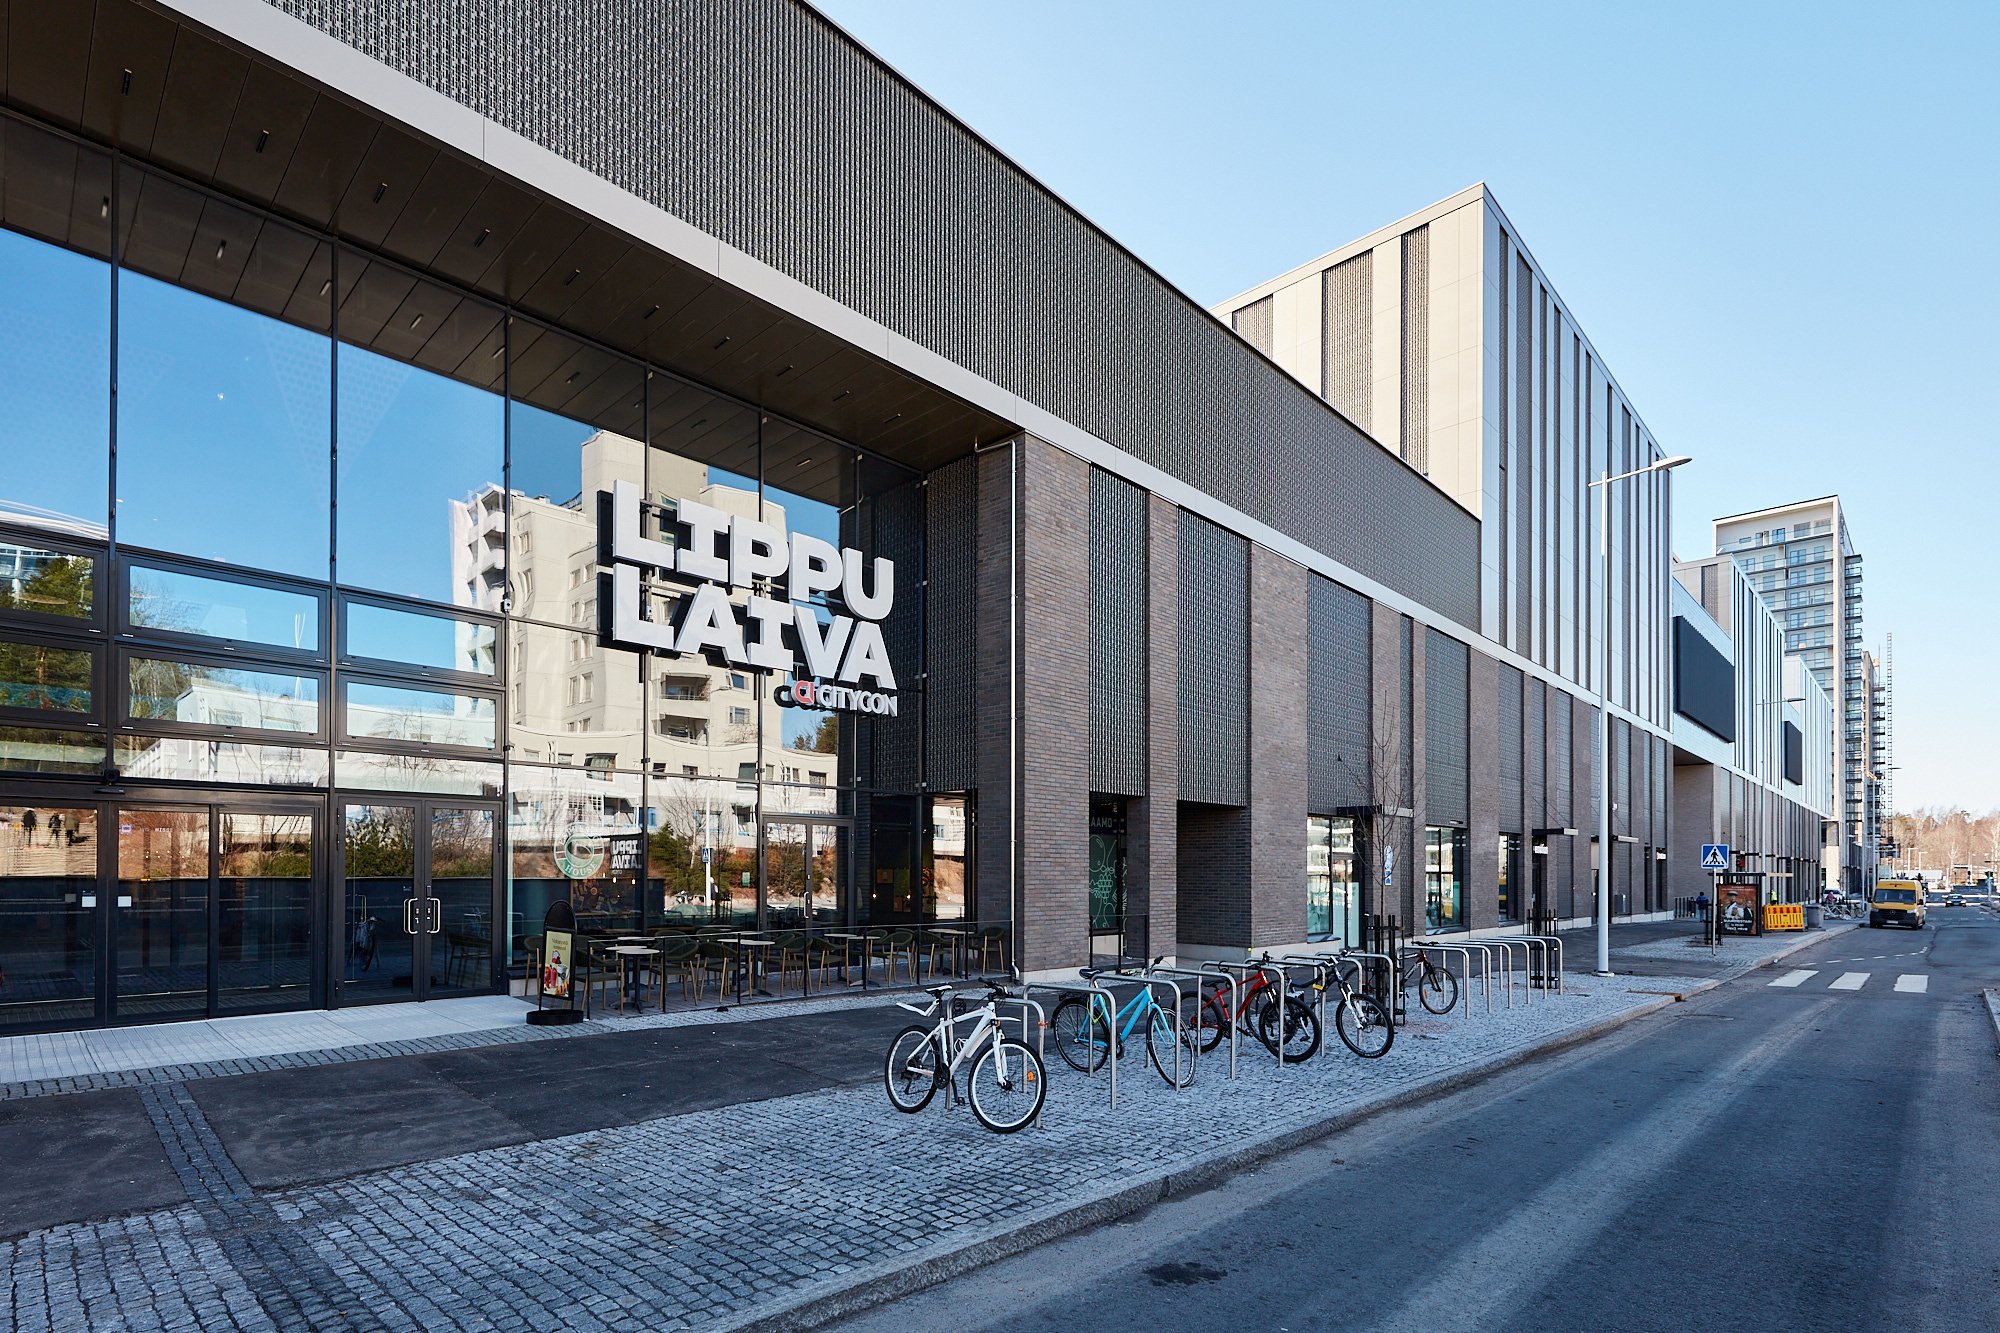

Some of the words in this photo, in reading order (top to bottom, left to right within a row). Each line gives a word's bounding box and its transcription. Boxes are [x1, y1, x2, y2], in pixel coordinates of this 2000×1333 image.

[613, 479, 894, 620] LIPPU
[613, 562, 898, 690] LAIVA
[816, 684, 898, 717] CITYCON
[564, 861, 598, 876] HOUSE
